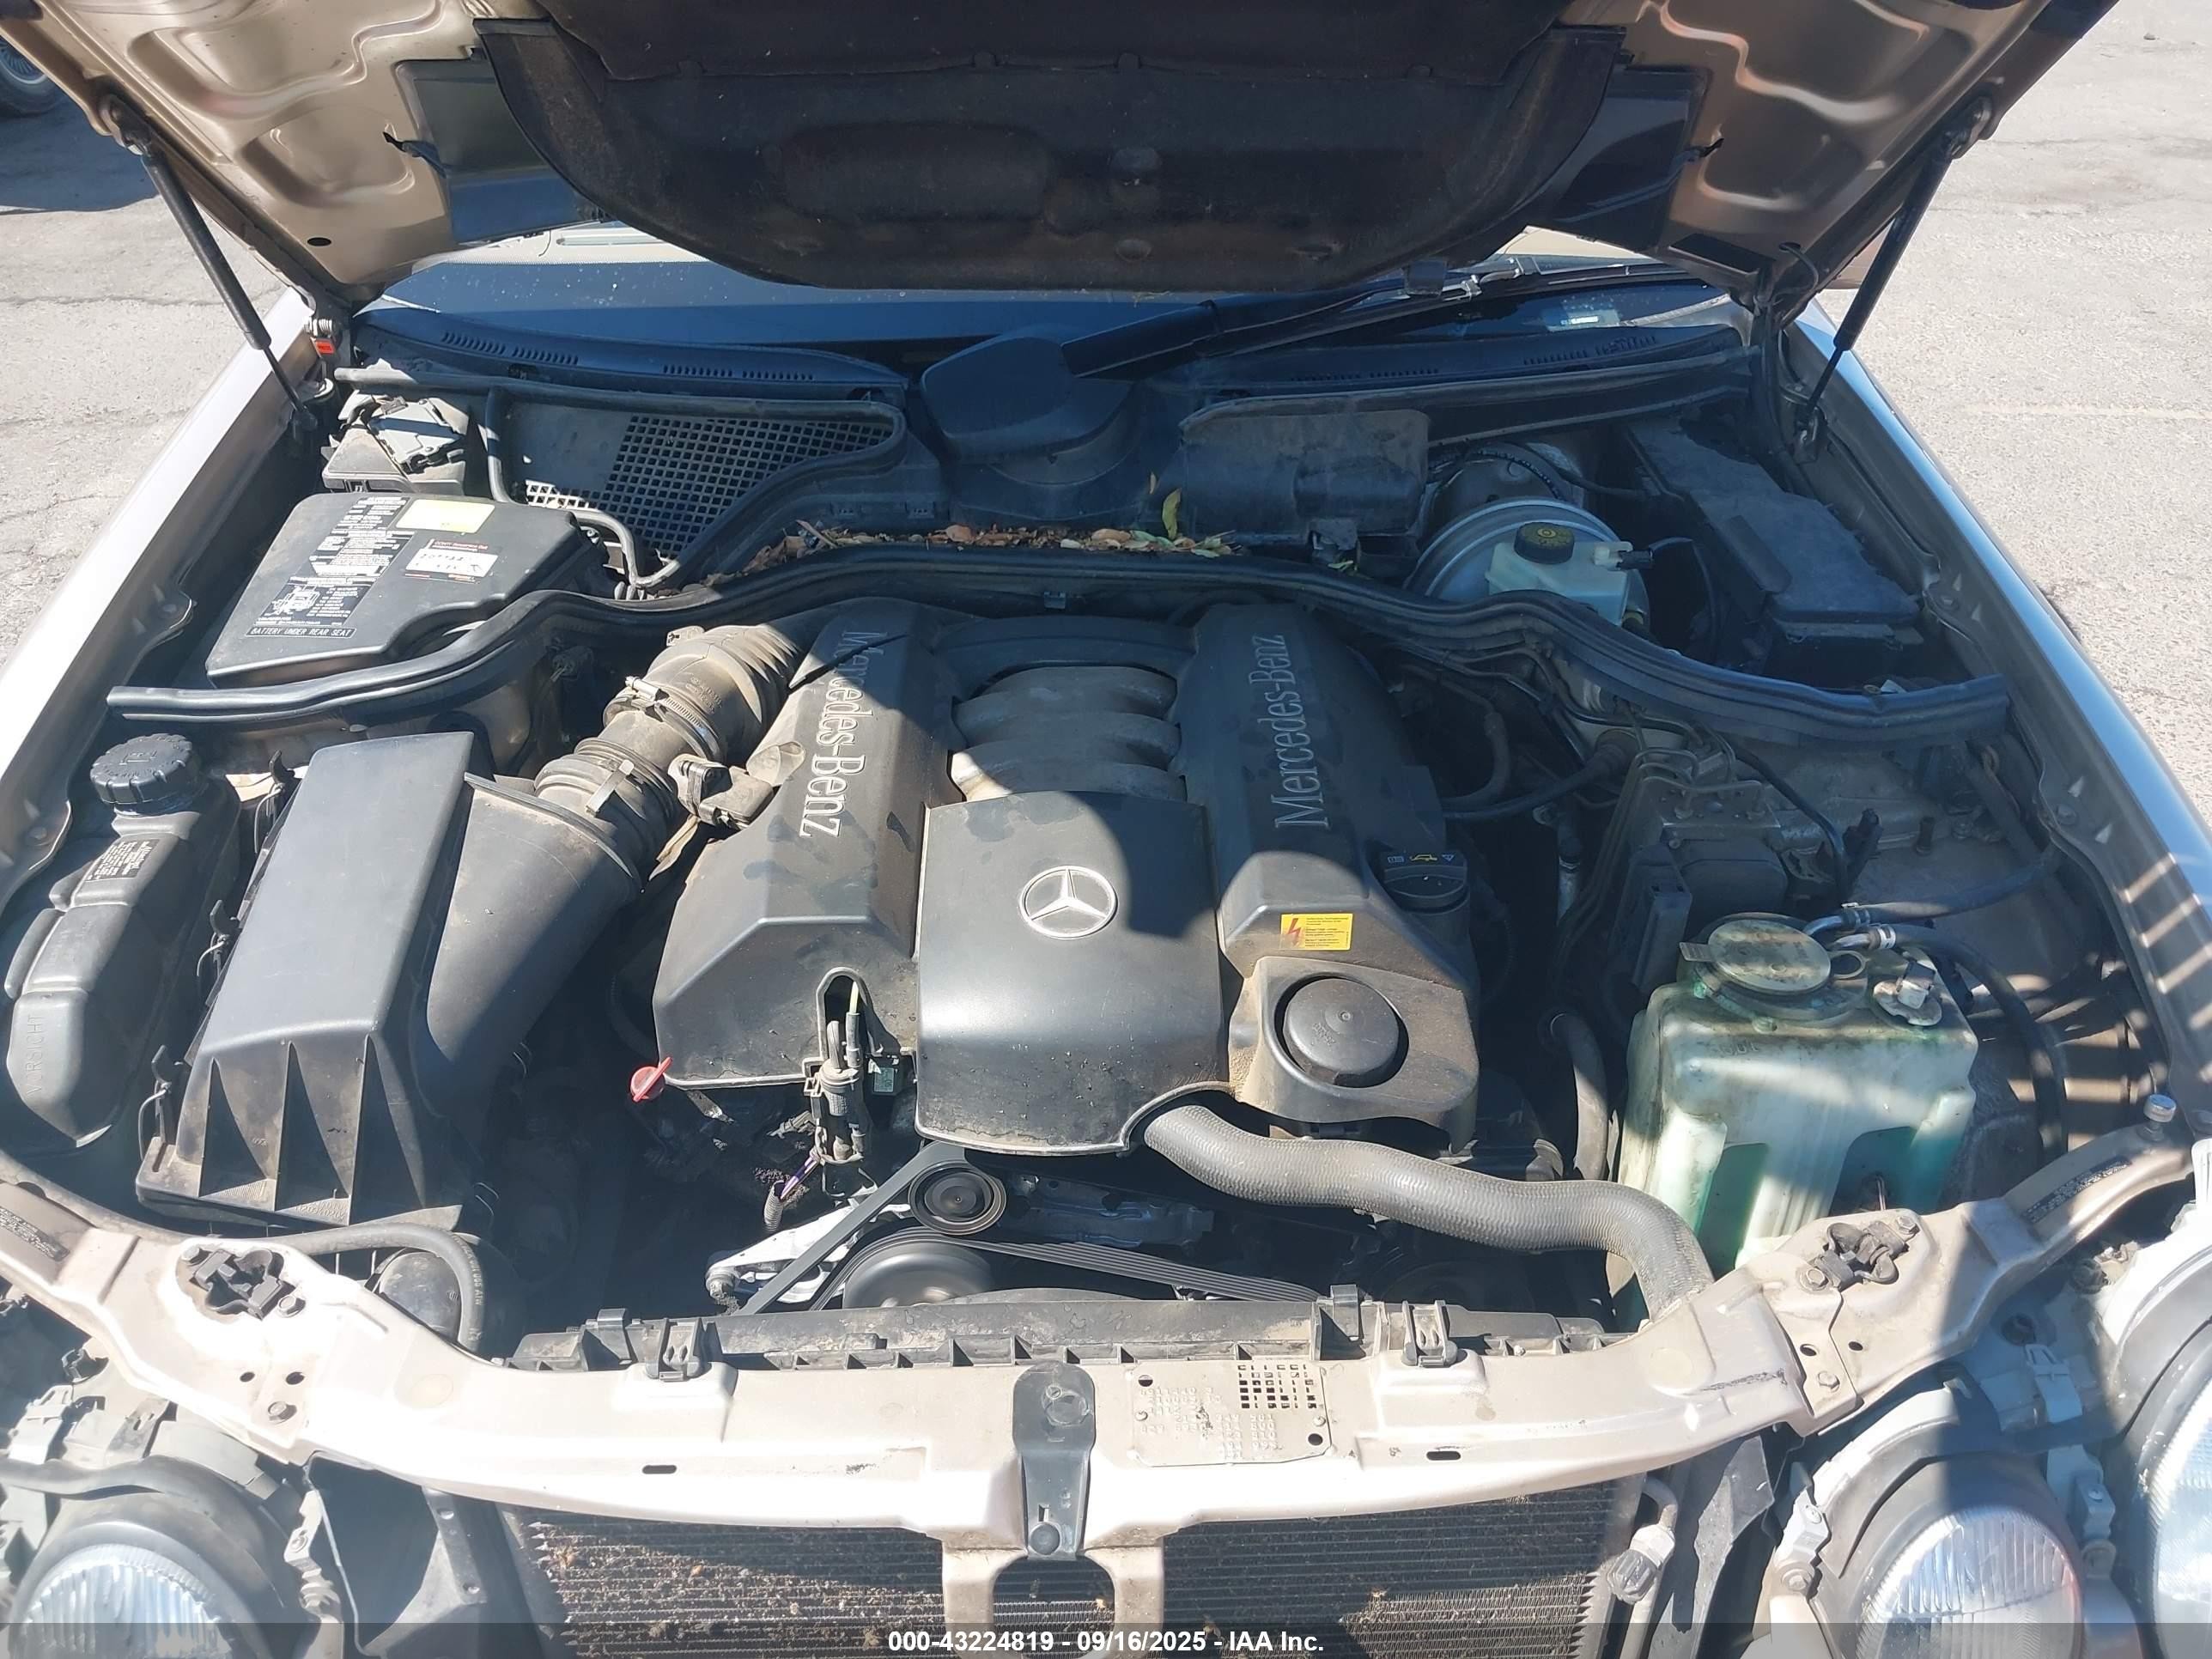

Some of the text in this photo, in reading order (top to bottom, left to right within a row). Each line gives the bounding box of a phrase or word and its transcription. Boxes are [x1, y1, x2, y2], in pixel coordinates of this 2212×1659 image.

[284, 627, 307, 635] UNDER
[331, 629, 351, 637] SEAT
[798, 630, 889, 838] Mercedes-Benz
[1248, 632, 1331, 831] Mercedes-Benz
[25, 1014, 44, 1097] VORSICHT
